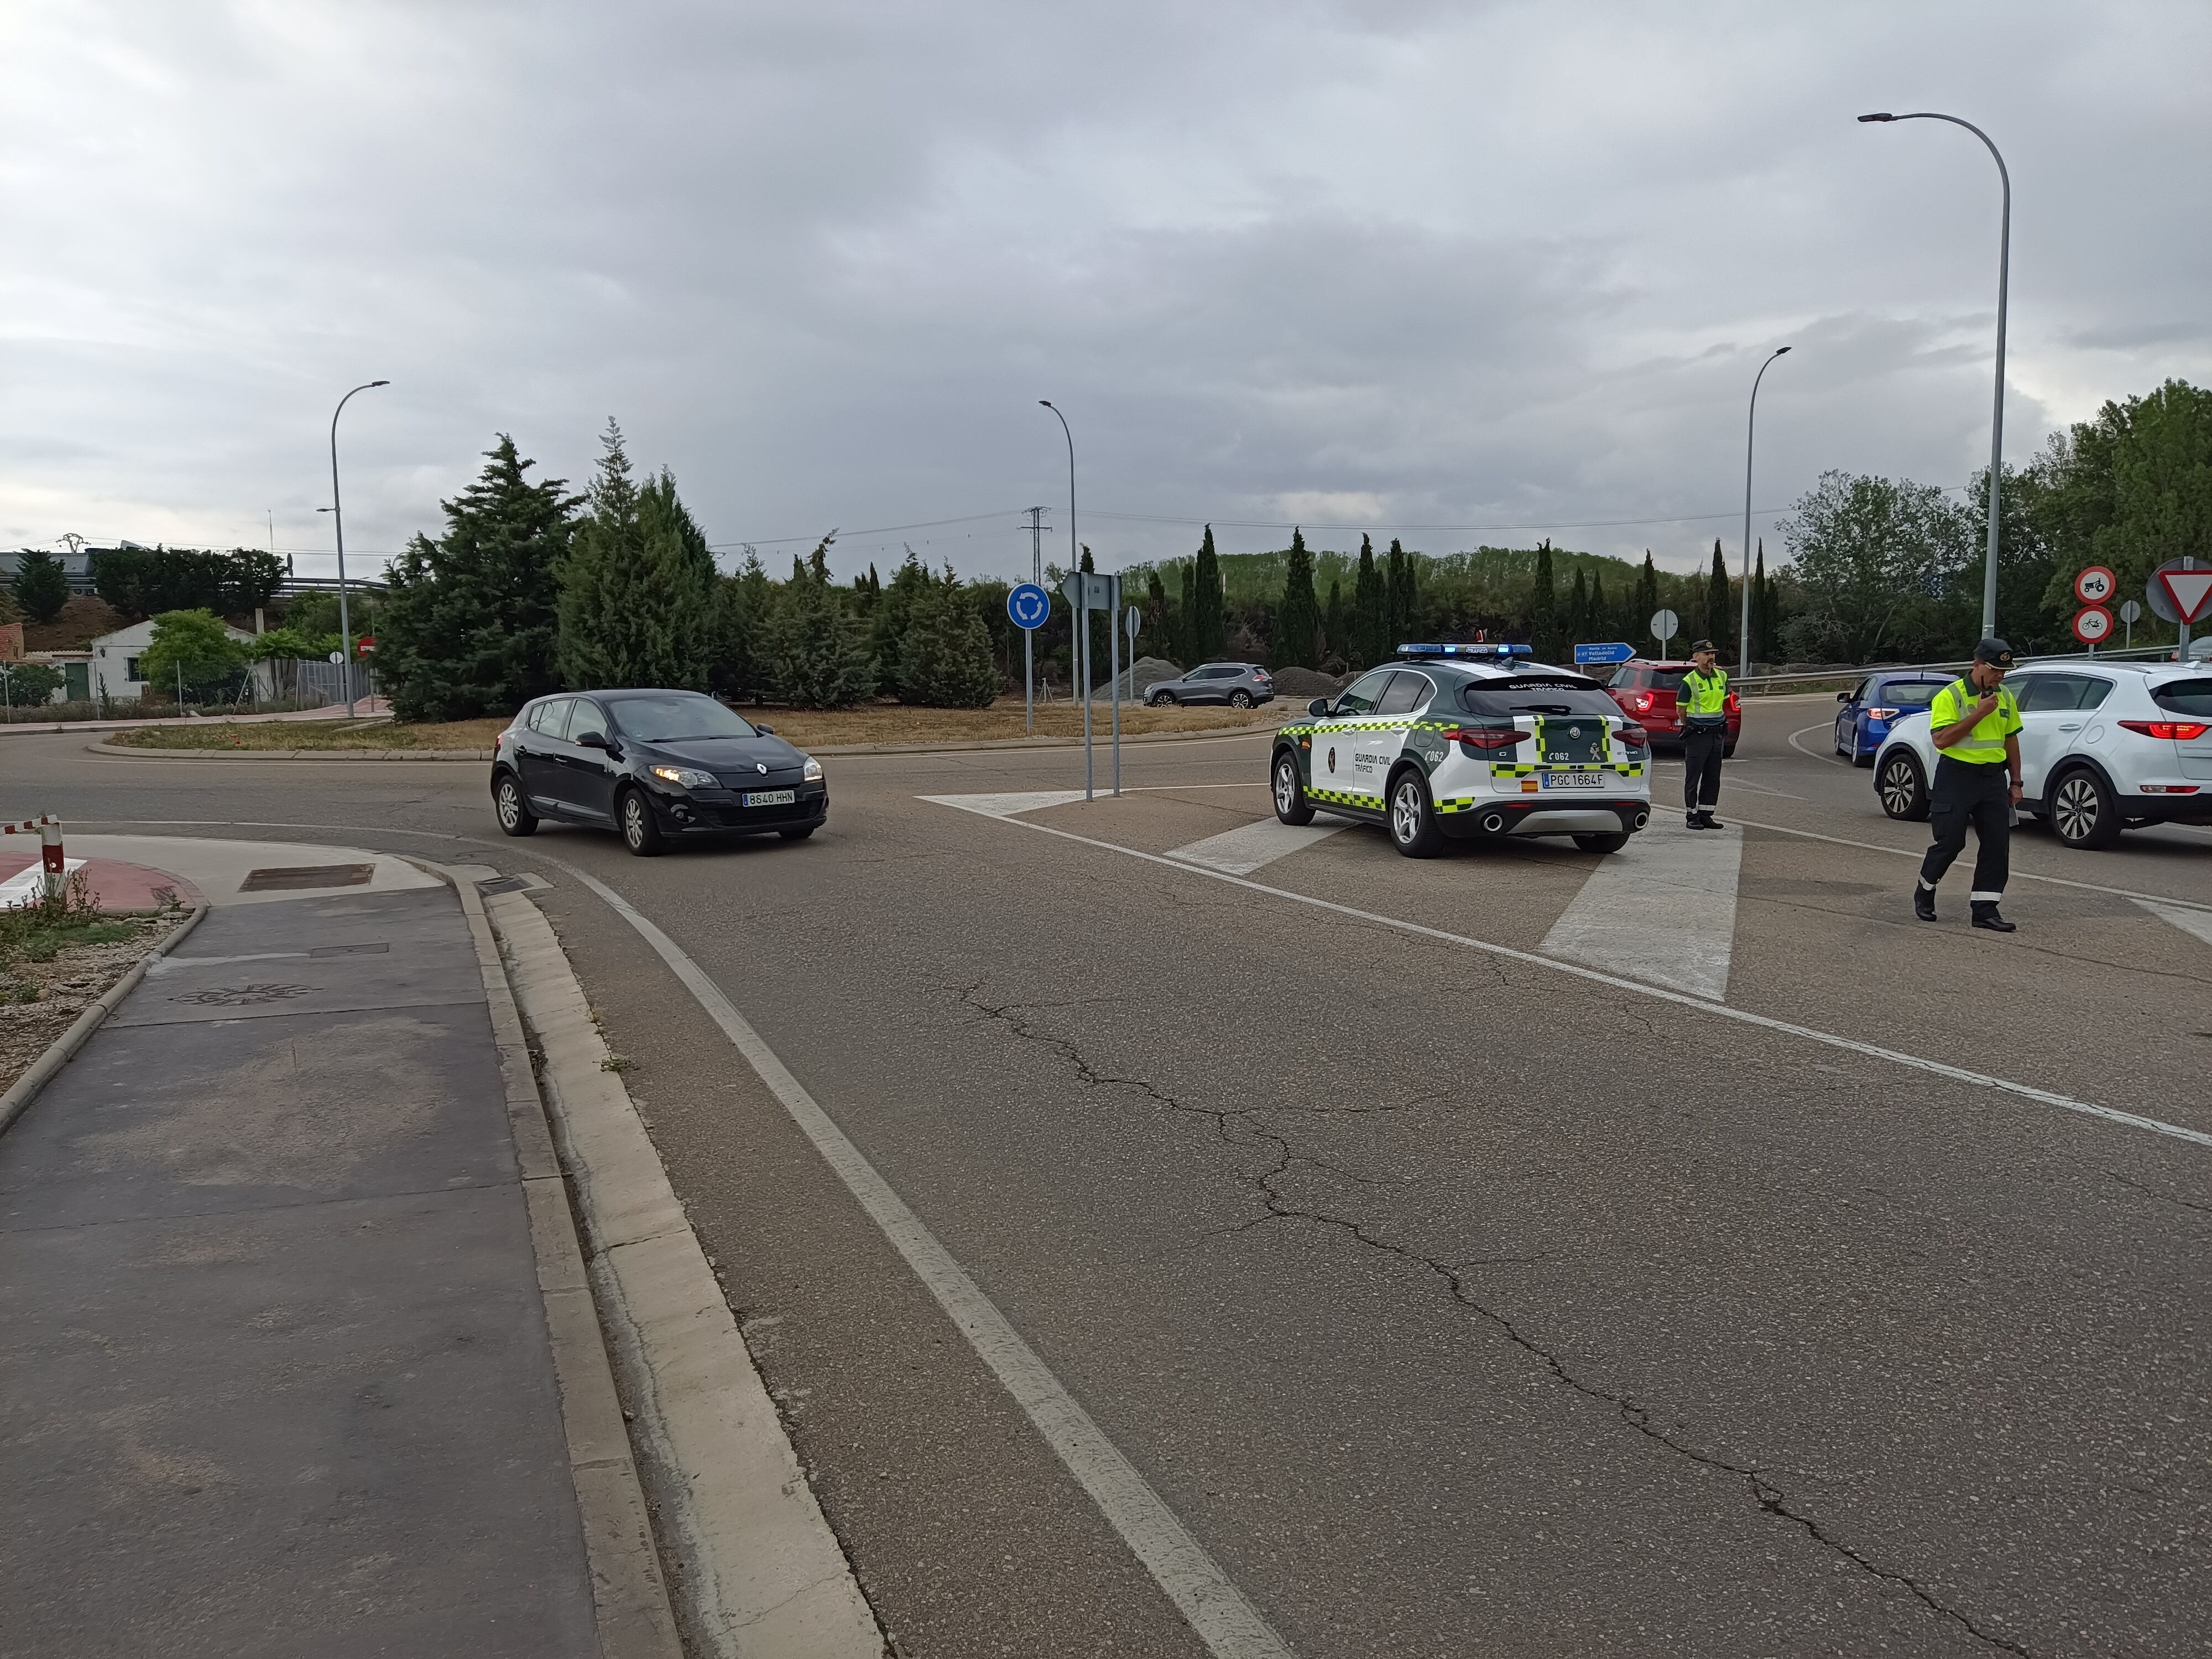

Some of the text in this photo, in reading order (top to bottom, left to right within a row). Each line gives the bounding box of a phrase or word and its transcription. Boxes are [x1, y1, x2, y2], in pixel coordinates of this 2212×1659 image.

[1355, 753, 1391, 765] GUARDIA CIVIL
[1430, 750, 1444, 763] 062
[1554, 752, 1569, 760] 062
[1551, 775, 1570, 785] PGC
[776, 791, 793, 802] HHN
